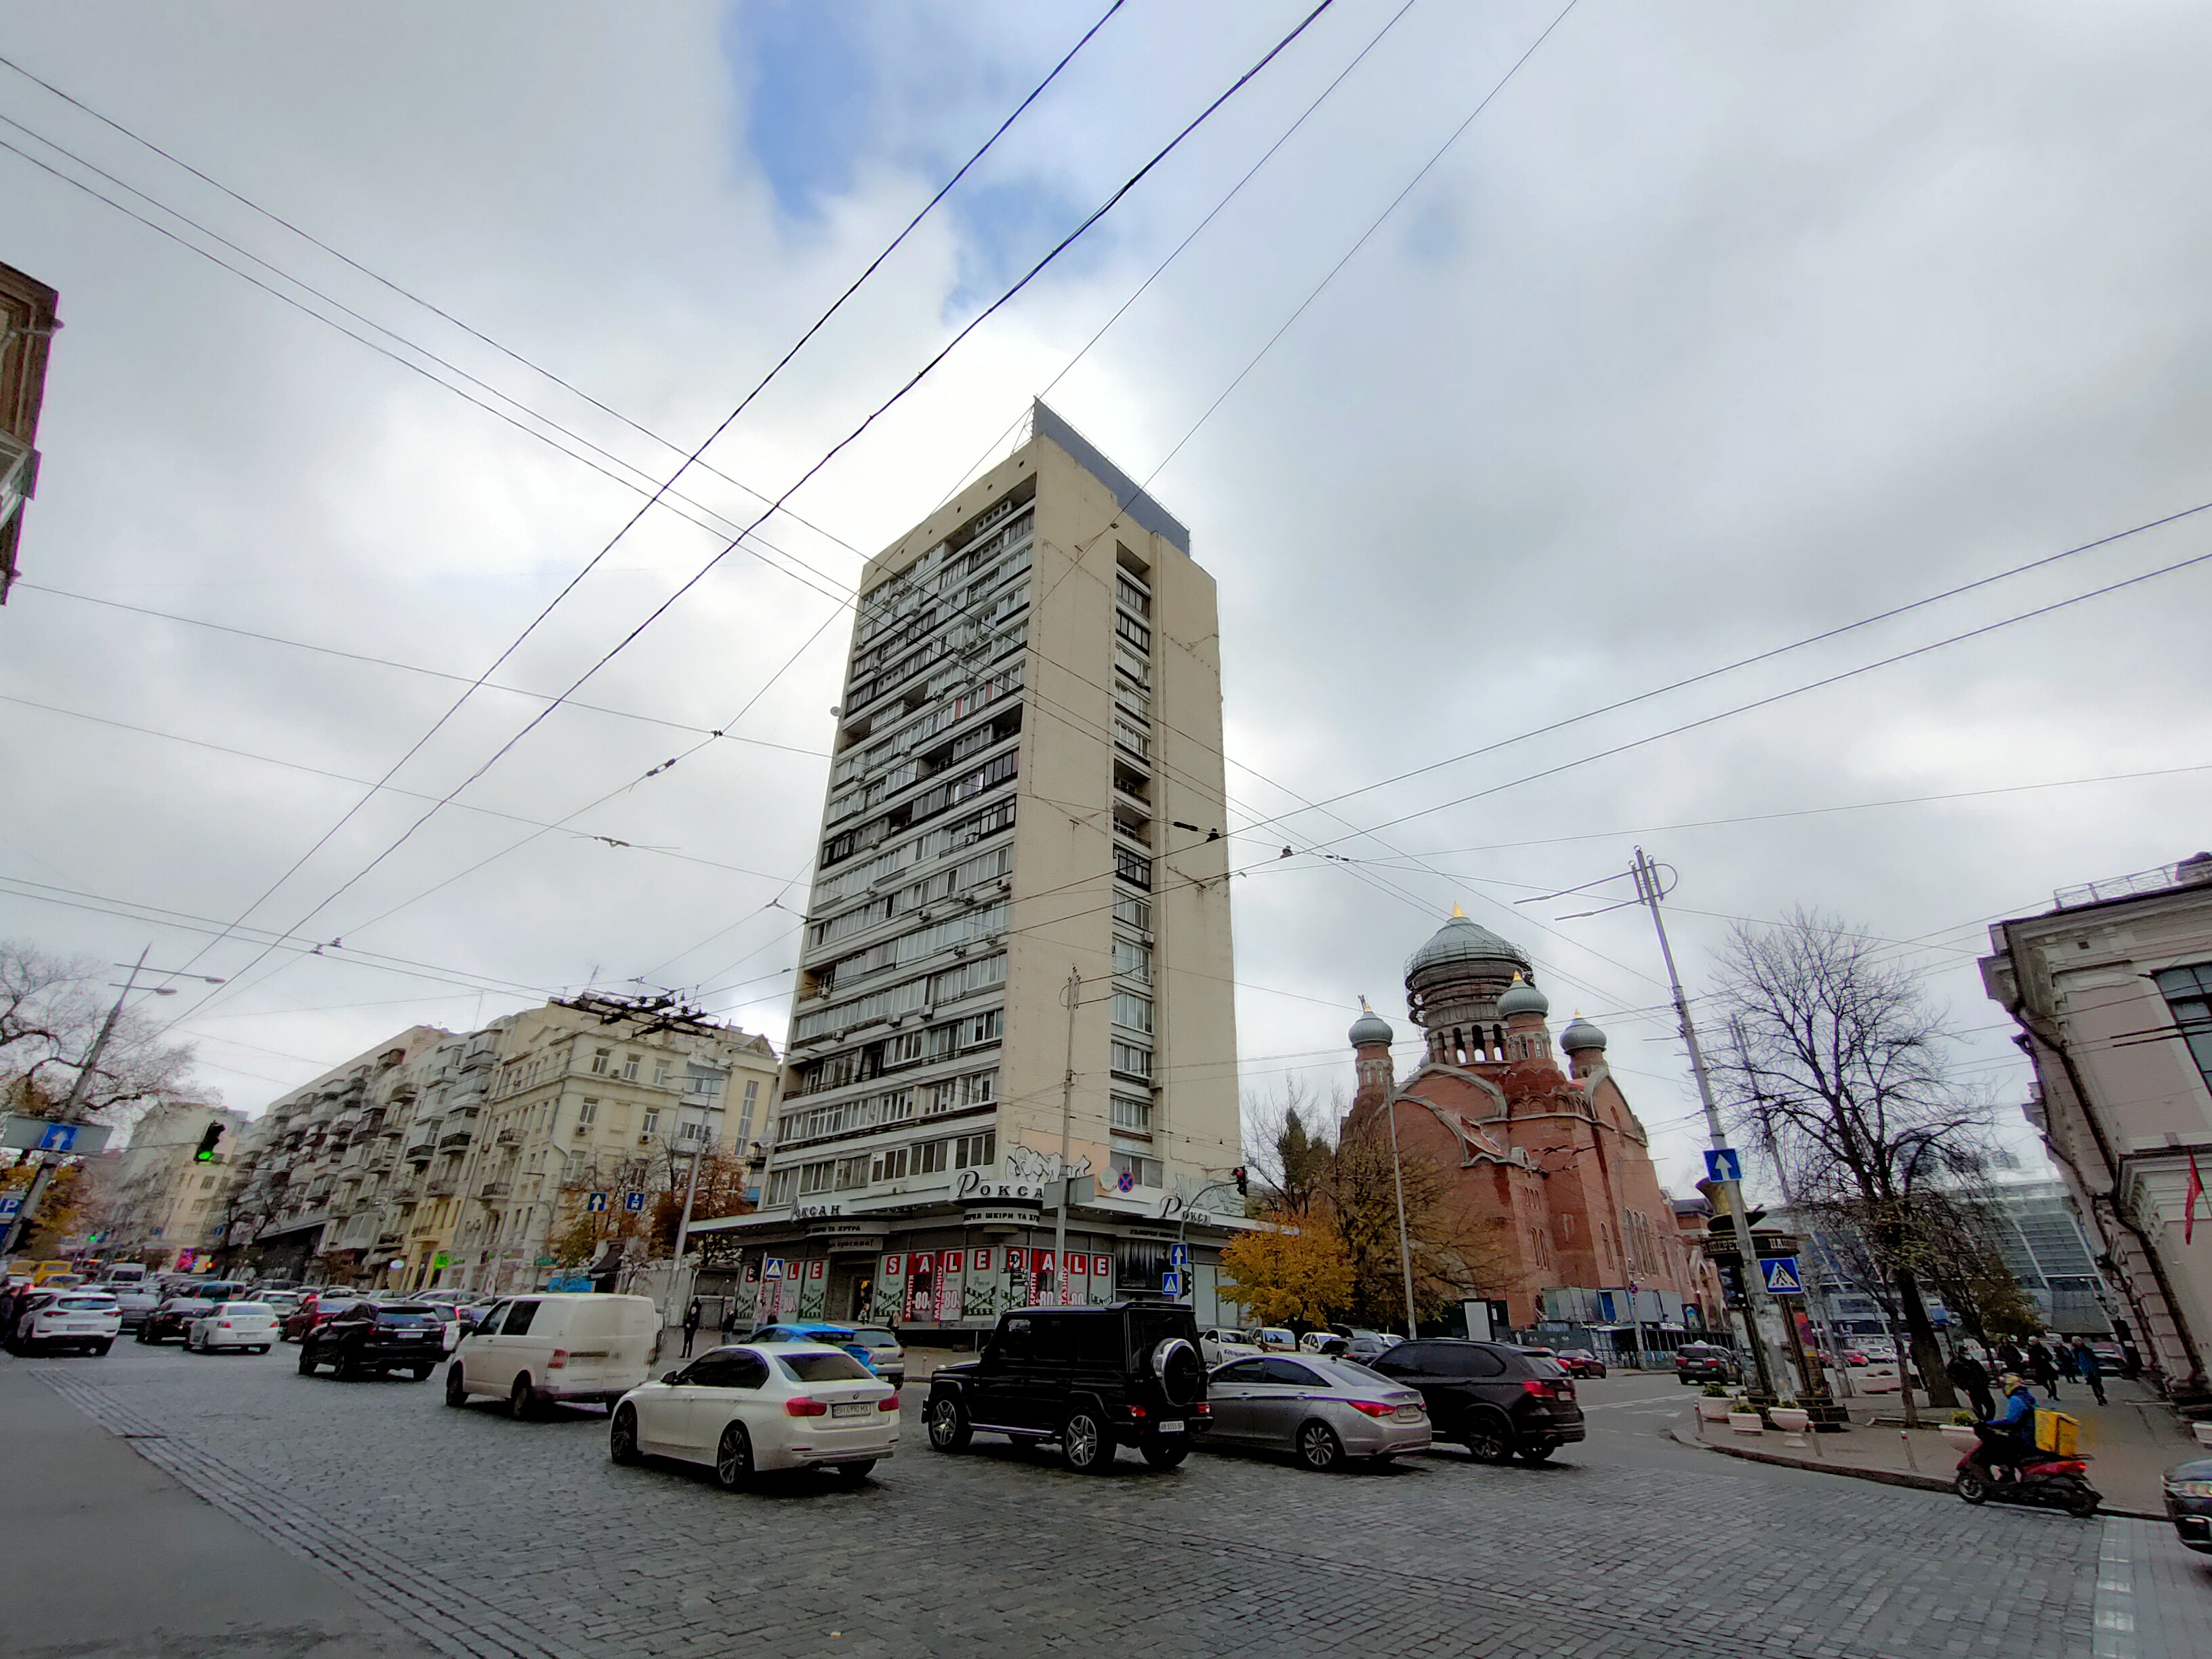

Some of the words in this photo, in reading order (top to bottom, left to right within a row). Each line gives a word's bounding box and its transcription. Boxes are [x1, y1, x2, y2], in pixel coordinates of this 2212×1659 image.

[958, 1170, 1044, 1199] РОКСА
[905, 1275, 914, 1319] ЗАКРИТТЯ
[934, 1265, 943, 1319] МАГАЗИНУ
